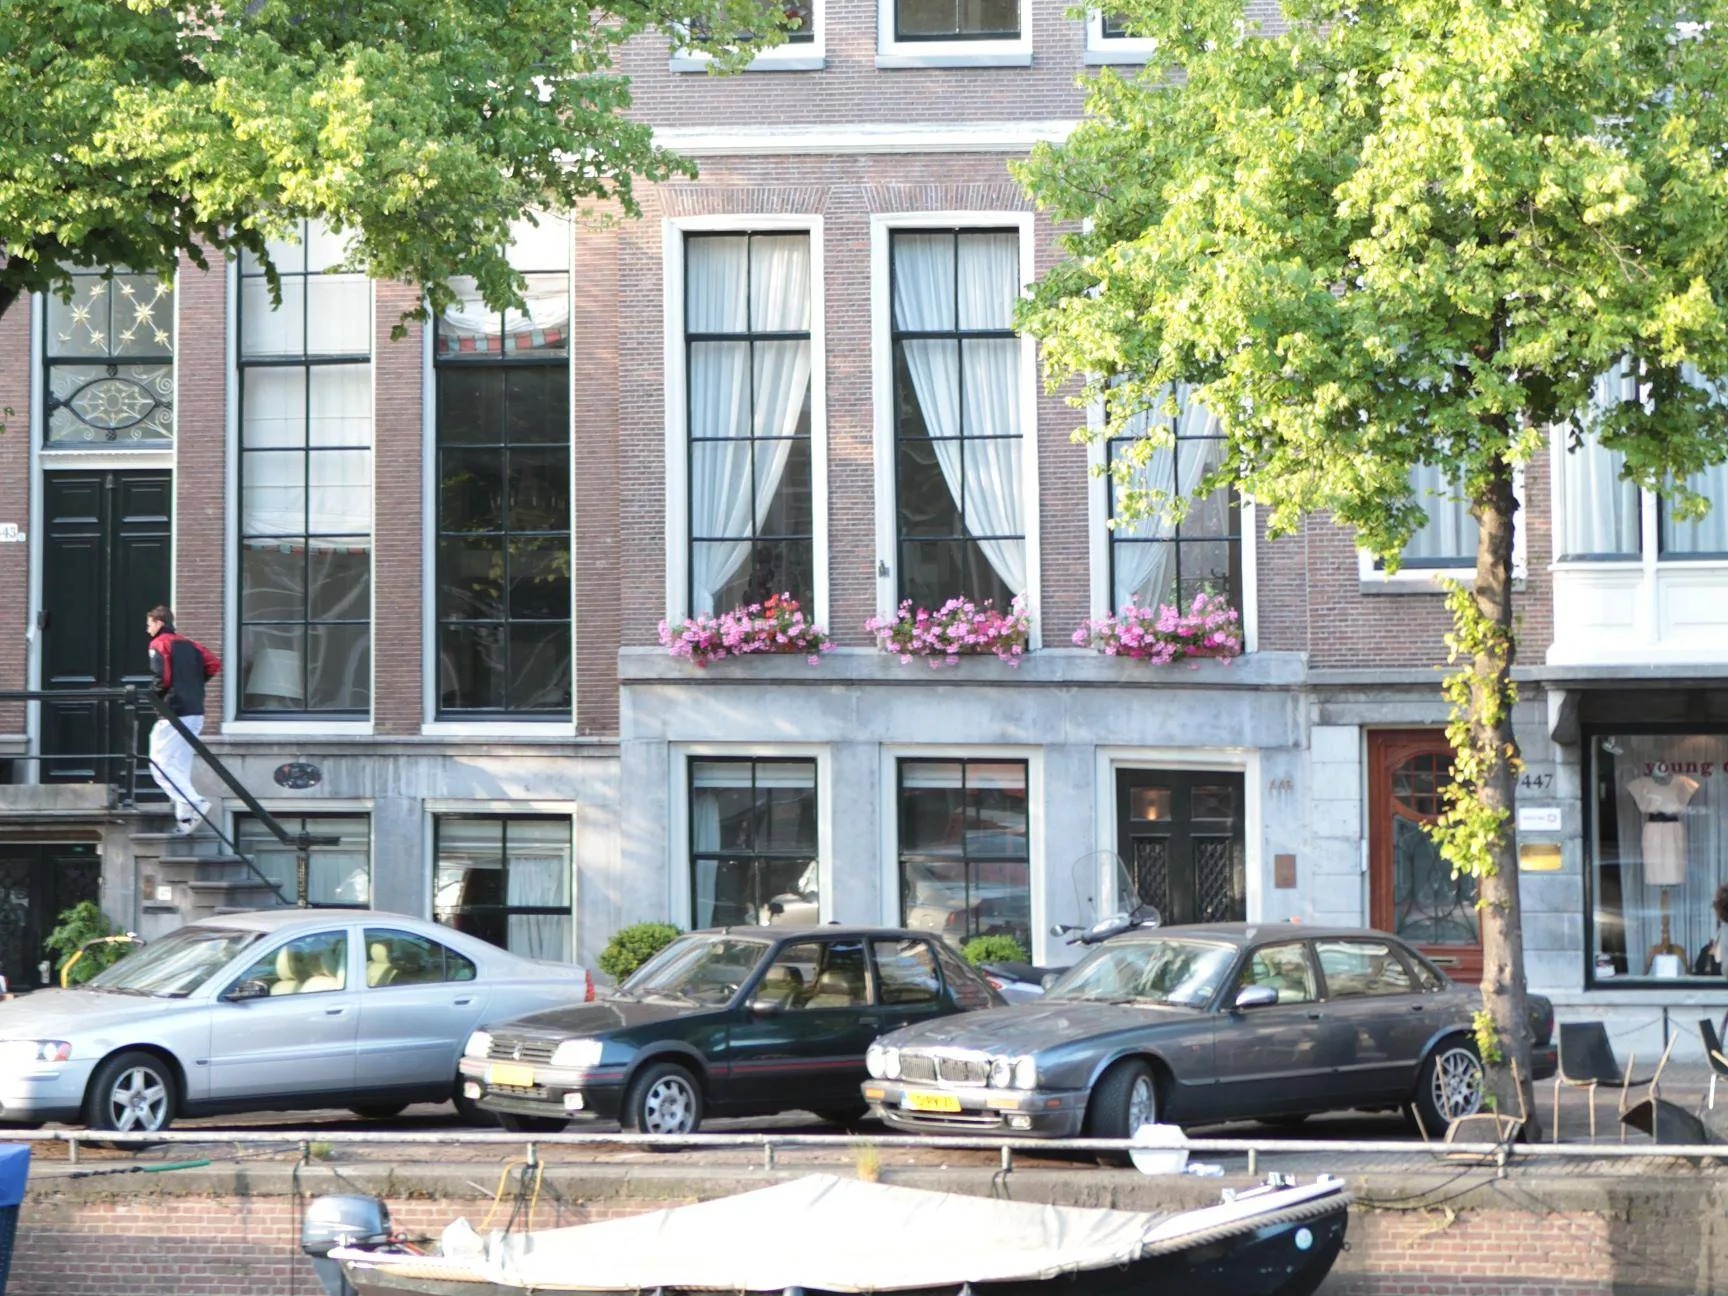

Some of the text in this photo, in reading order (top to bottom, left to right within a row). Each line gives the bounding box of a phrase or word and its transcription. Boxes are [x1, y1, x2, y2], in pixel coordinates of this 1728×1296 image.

[0, 527, 16, 539] 43
[1644, 761, 1714, 777] young
[1521, 774, 1553, 789] 447
